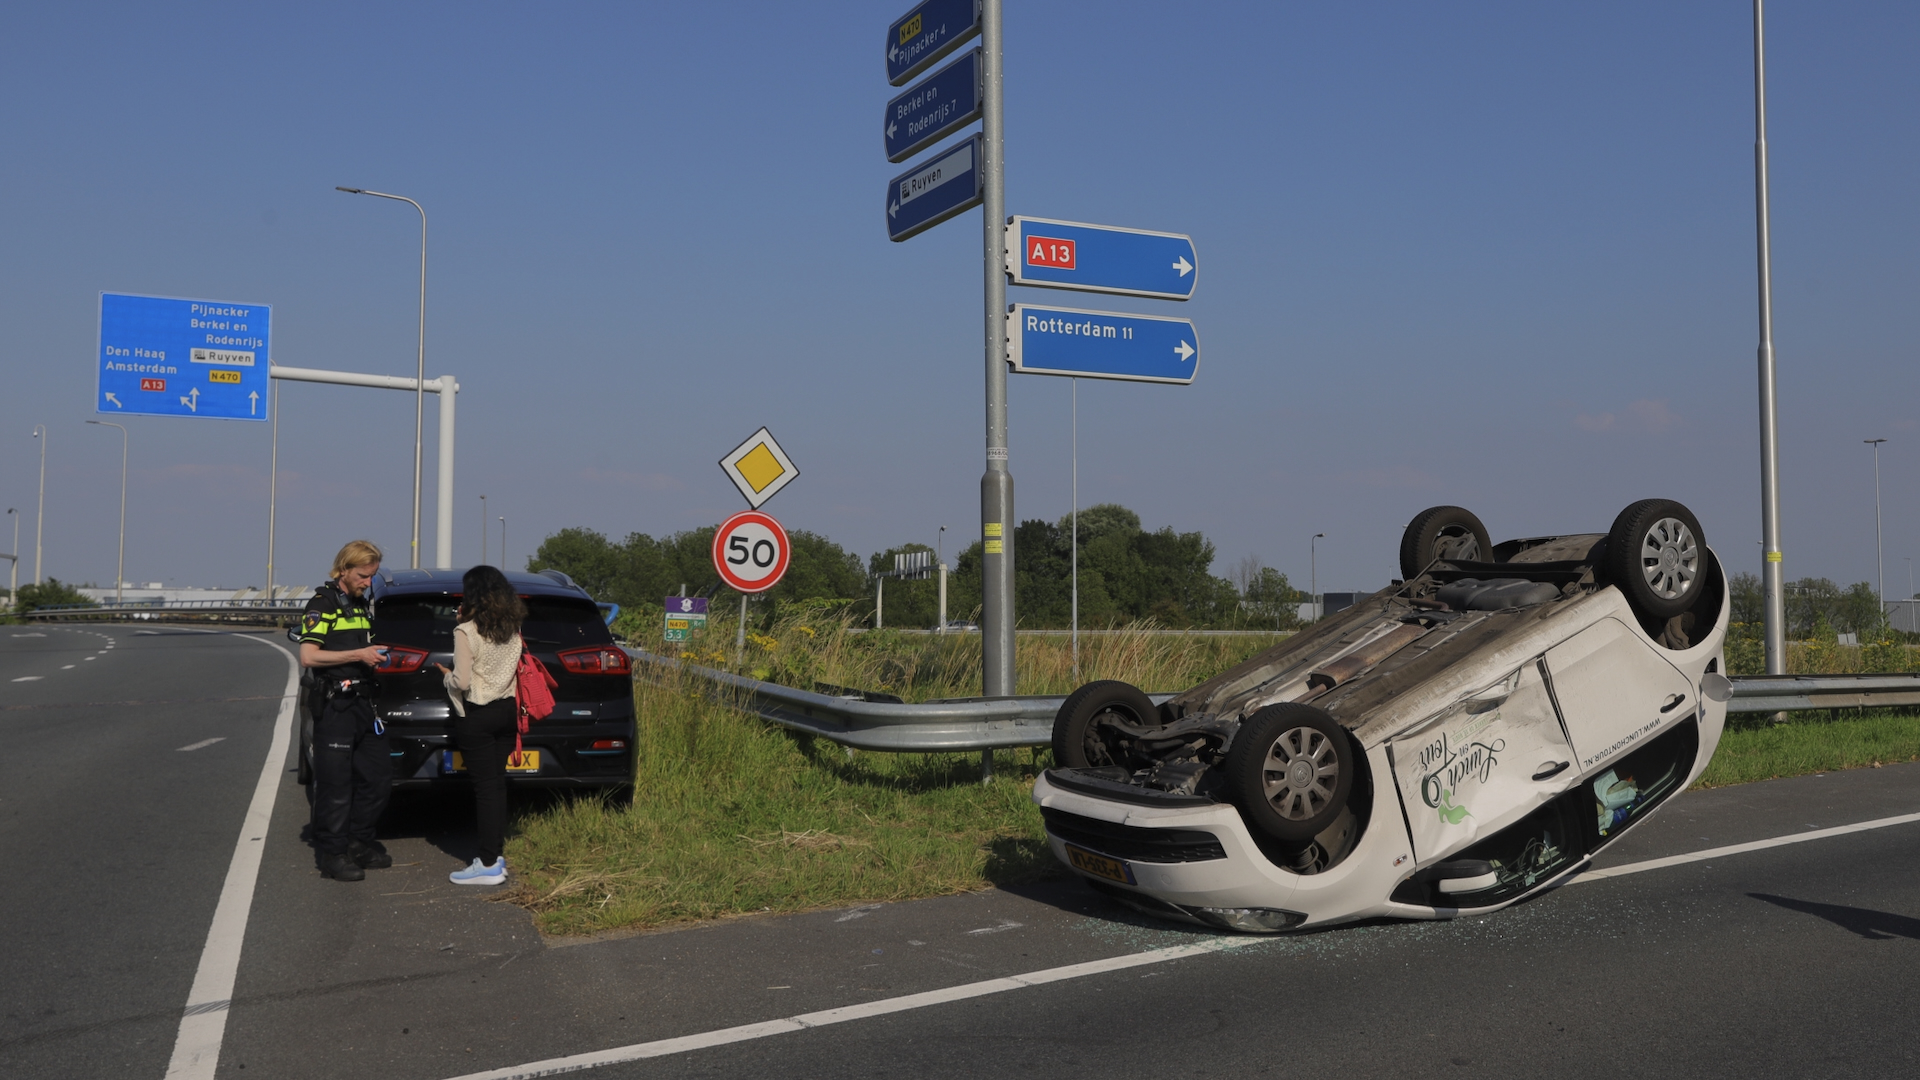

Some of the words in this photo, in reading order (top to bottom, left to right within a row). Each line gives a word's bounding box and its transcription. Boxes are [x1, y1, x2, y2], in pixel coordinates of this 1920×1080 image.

[899, 29, 939, 65] Pijnacker
[940, 23, 946, 35] 4
[898, 91, 924, 119] Berkel
[927, 87, 937, 99] en
[908, 104, 949, 137] Rodenrijs
[951, 99, 956, 111] 7
[911, 168, 942, 193] Ruyven
[191, 304, 249, 317] Pijnacker
[191, 319, 230, 330] Berkel
[233, 323, 247, 332] en
[1027, 316, 1116, 338] Rotterdam
[1122, 326, 1133, 340] 11
[106, 346, 130, 356] Den
[135, 348, 165, 361] Haag
[206, 334, 263, 349] Rodenrijs
[105, 361, 177, 374] Amsterdam
[209, 352, 251, 364] Ruyven
[727, 536, 775, 567] 50
[1418, 732, 1457, 775] Tour
[1583, 717, 1662, 768] WWW.LUNCHONTOUR.NL
[1446, 739, 1506, 796] Lunch
